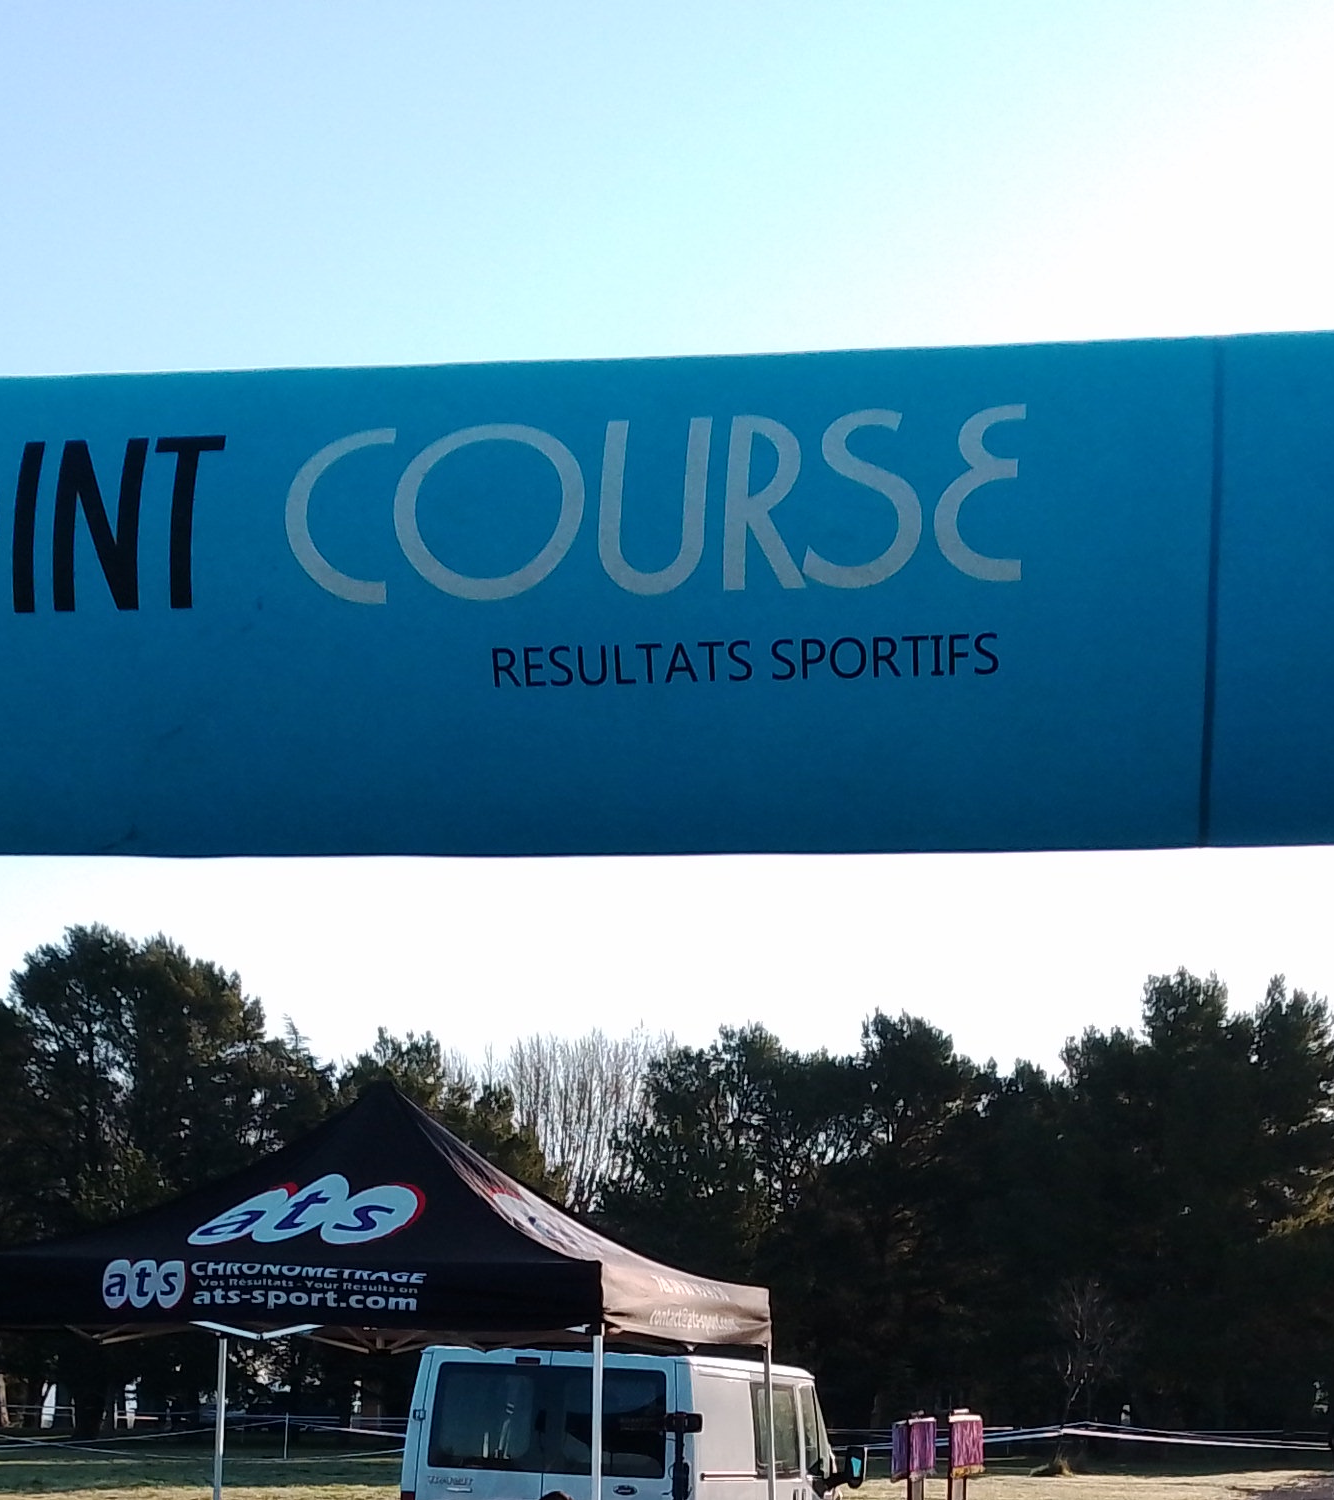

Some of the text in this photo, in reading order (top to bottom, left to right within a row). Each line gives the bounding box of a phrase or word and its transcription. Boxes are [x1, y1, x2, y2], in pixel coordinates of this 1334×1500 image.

[284, 403, 1027, 604] COURSE
[491, 632, 1000, 688] RESULTATS SPORTIFS
[103, 1265, 180, 1299] ats
[191, 1261, 428, 1285] CHRONOMETRAGE
[198, 1278, 225, 1288] Vos
[305, 1279, 340, 1291] Your
[342, 1281, 396, 1294] Results
[398, 1285, 419, 1295] on
[192, 1288, 419, 1311] ats-sport.com
